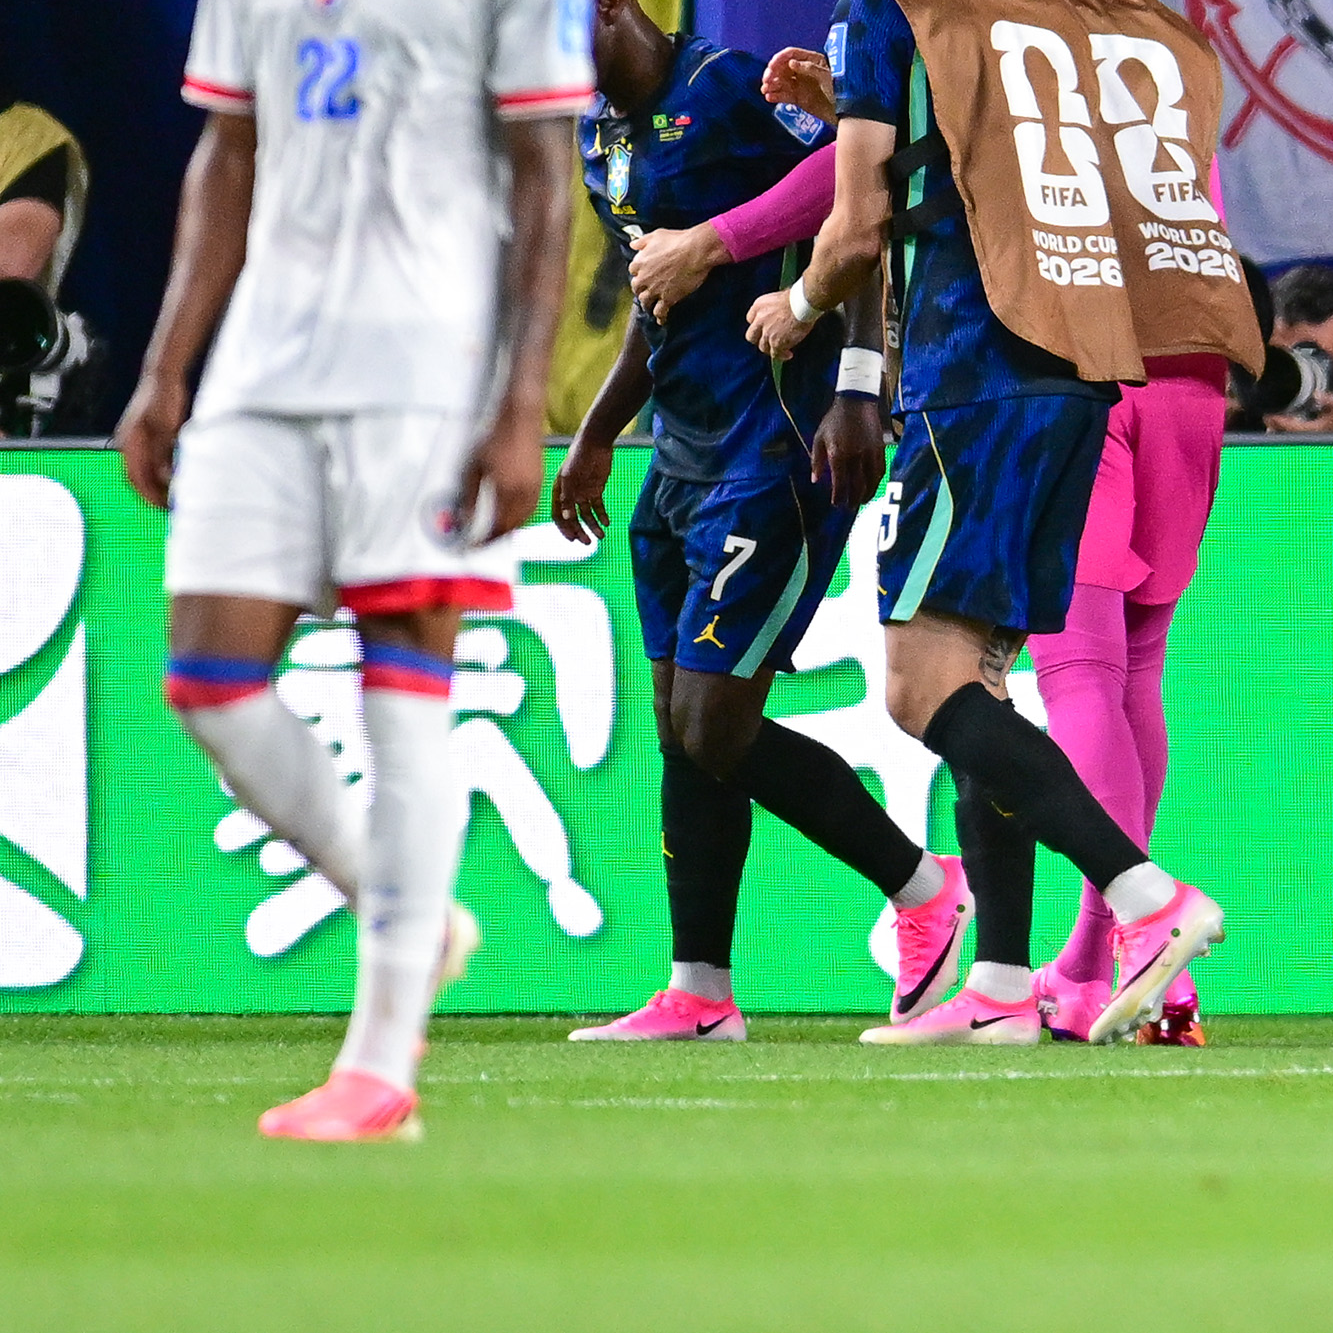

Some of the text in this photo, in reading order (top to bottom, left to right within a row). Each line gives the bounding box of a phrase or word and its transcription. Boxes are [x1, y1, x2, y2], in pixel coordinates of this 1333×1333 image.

[297, 36, 361, 122] 22
[1040, 184, 1089, 208] FIFA
[1084, 235, 1119, 255] CUP
[1138, 222, 1207, 247] WORLD
[1035, 250, 1125, 288] 2026
[1144, 242, 1242, 284] 2026
[710, 534, 758, 602] 7
